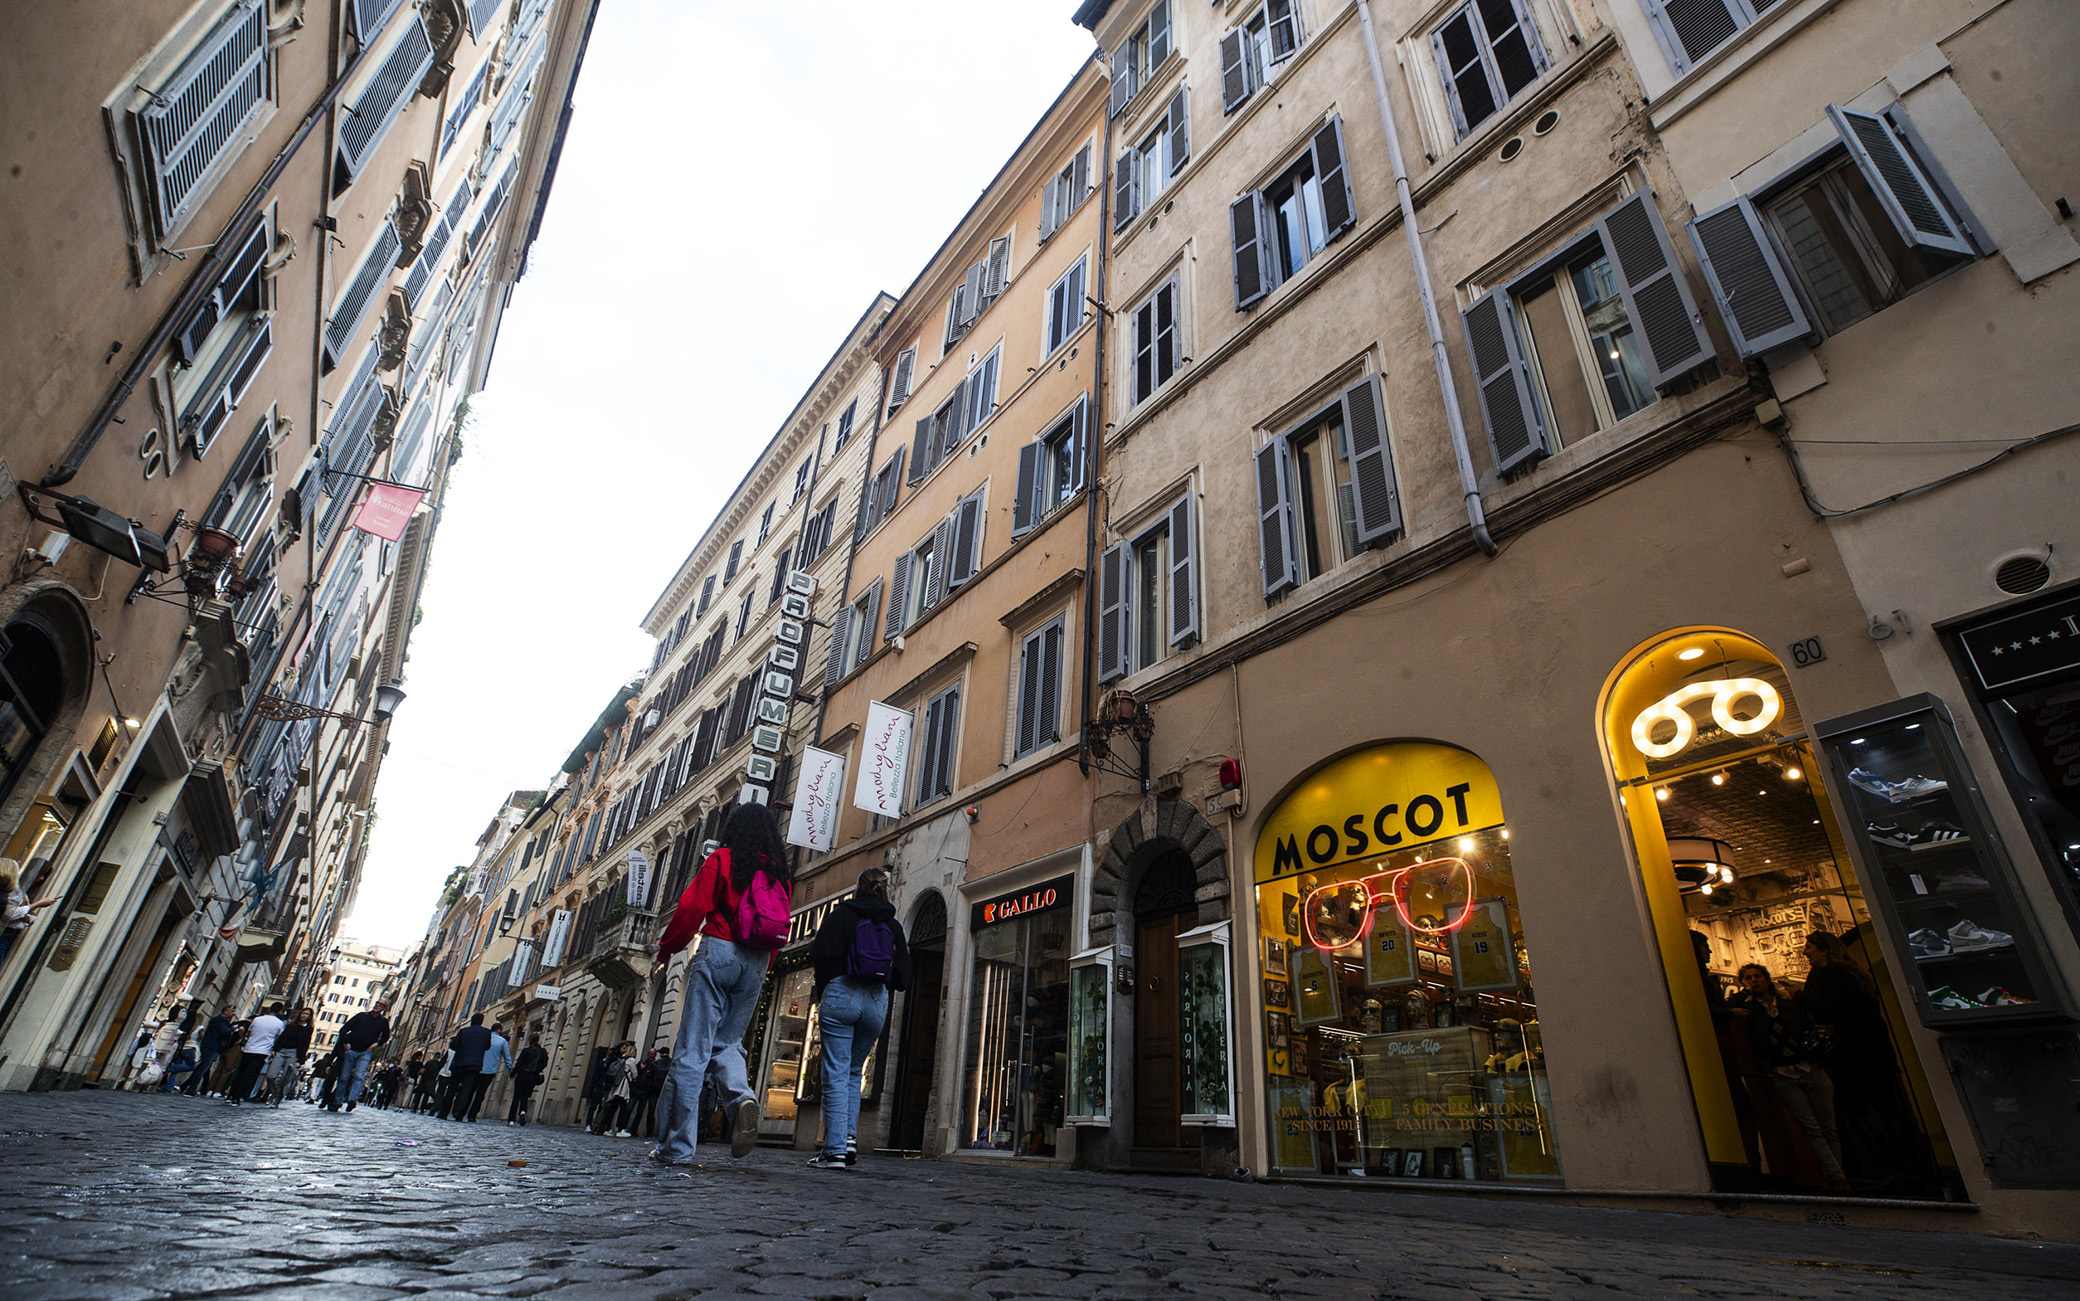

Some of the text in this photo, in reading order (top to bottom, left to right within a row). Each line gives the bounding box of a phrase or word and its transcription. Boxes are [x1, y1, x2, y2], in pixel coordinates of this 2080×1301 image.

[1792, 638, 1822, 664] 60
[869, 716, 901, 810] modigliani
[890, 729, 906, 799] Bellezza Italiana
[802, 758, 832, 844] modigliani
[819, 771, 836, 835] Bellezza Italiana
[1272, 782, 1471, 876] MOSCOT
[998, 888, 1057, 919] GALLO
[1382, 939, 1395, 951] 20
[1474, 941, 1489, 954] 19
[1311, 980, 1318, 991] 5
[1097, 985, 1105, 1095] SARTORIA
[1387, 1038, 1442, 1057] Pick-Up
[1272, 1105, 1301, 1118] NEW
[1305, 1104, 1343, 1118] YORK
[1402, 1103, 1410, 1116] 5
[1413, 1102, 1536, 1116] GENERATIONS
[1288, 1120, 1333, 1132] SINCE
[1396, 1119, 1455, 1131] FAMILY
[1460, 1118, 1548, 1132] BUSINESS
